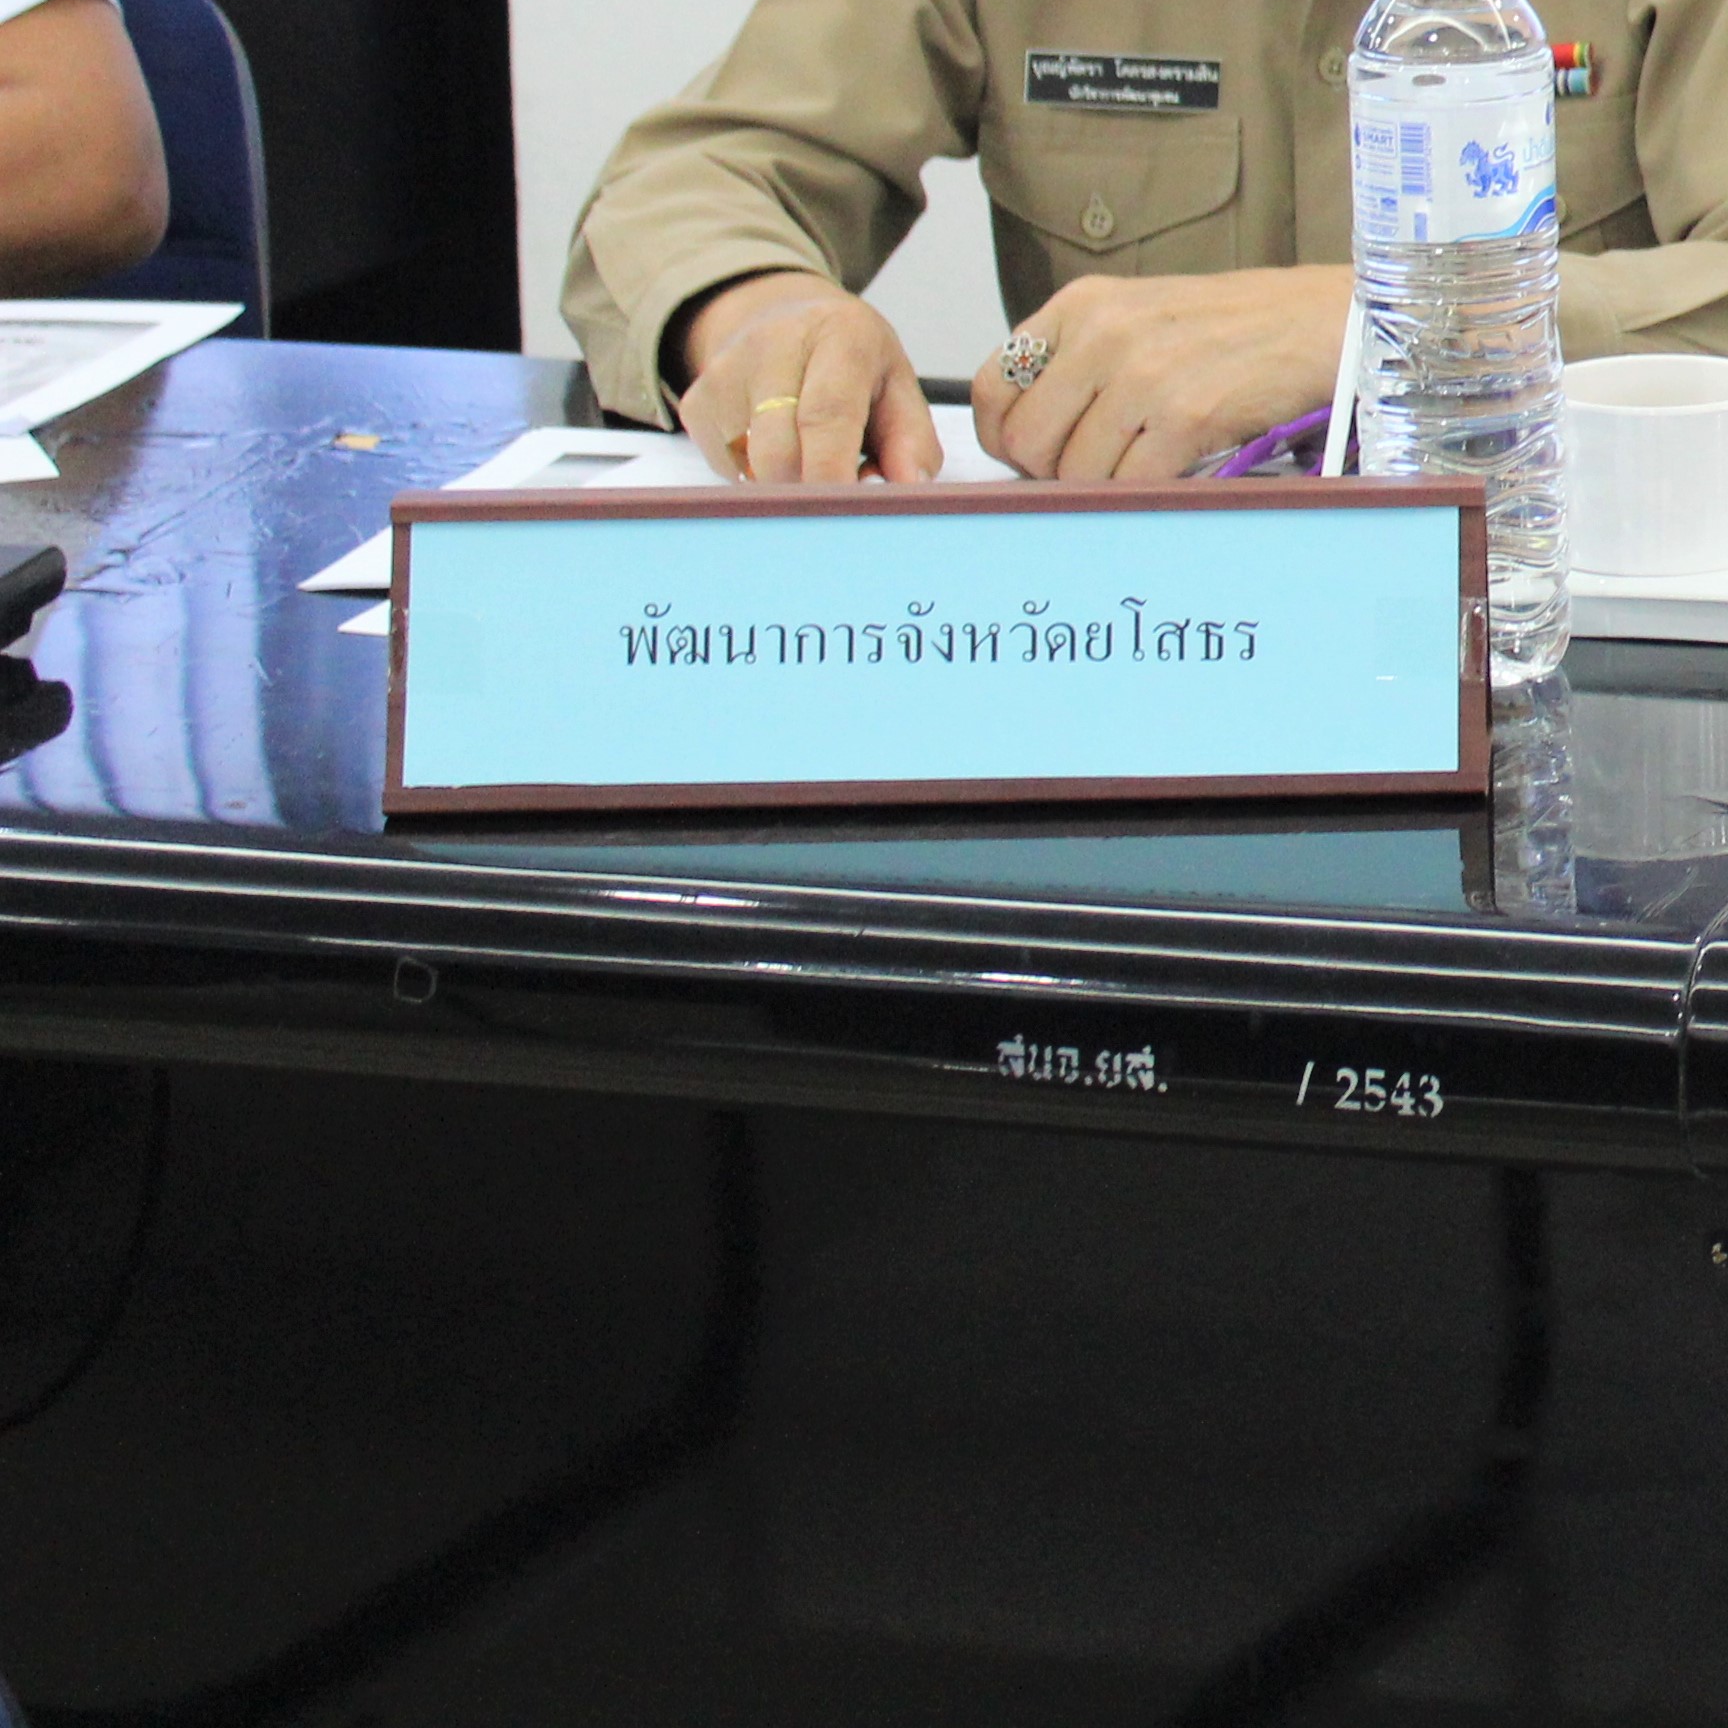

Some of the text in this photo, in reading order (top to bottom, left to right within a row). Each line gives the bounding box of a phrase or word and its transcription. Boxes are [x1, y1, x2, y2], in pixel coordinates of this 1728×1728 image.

[626, 597, 1258, 665] พัฒนาการจังหวัดยโสธร
[1334, 1068, 1444, 1118] 2543
